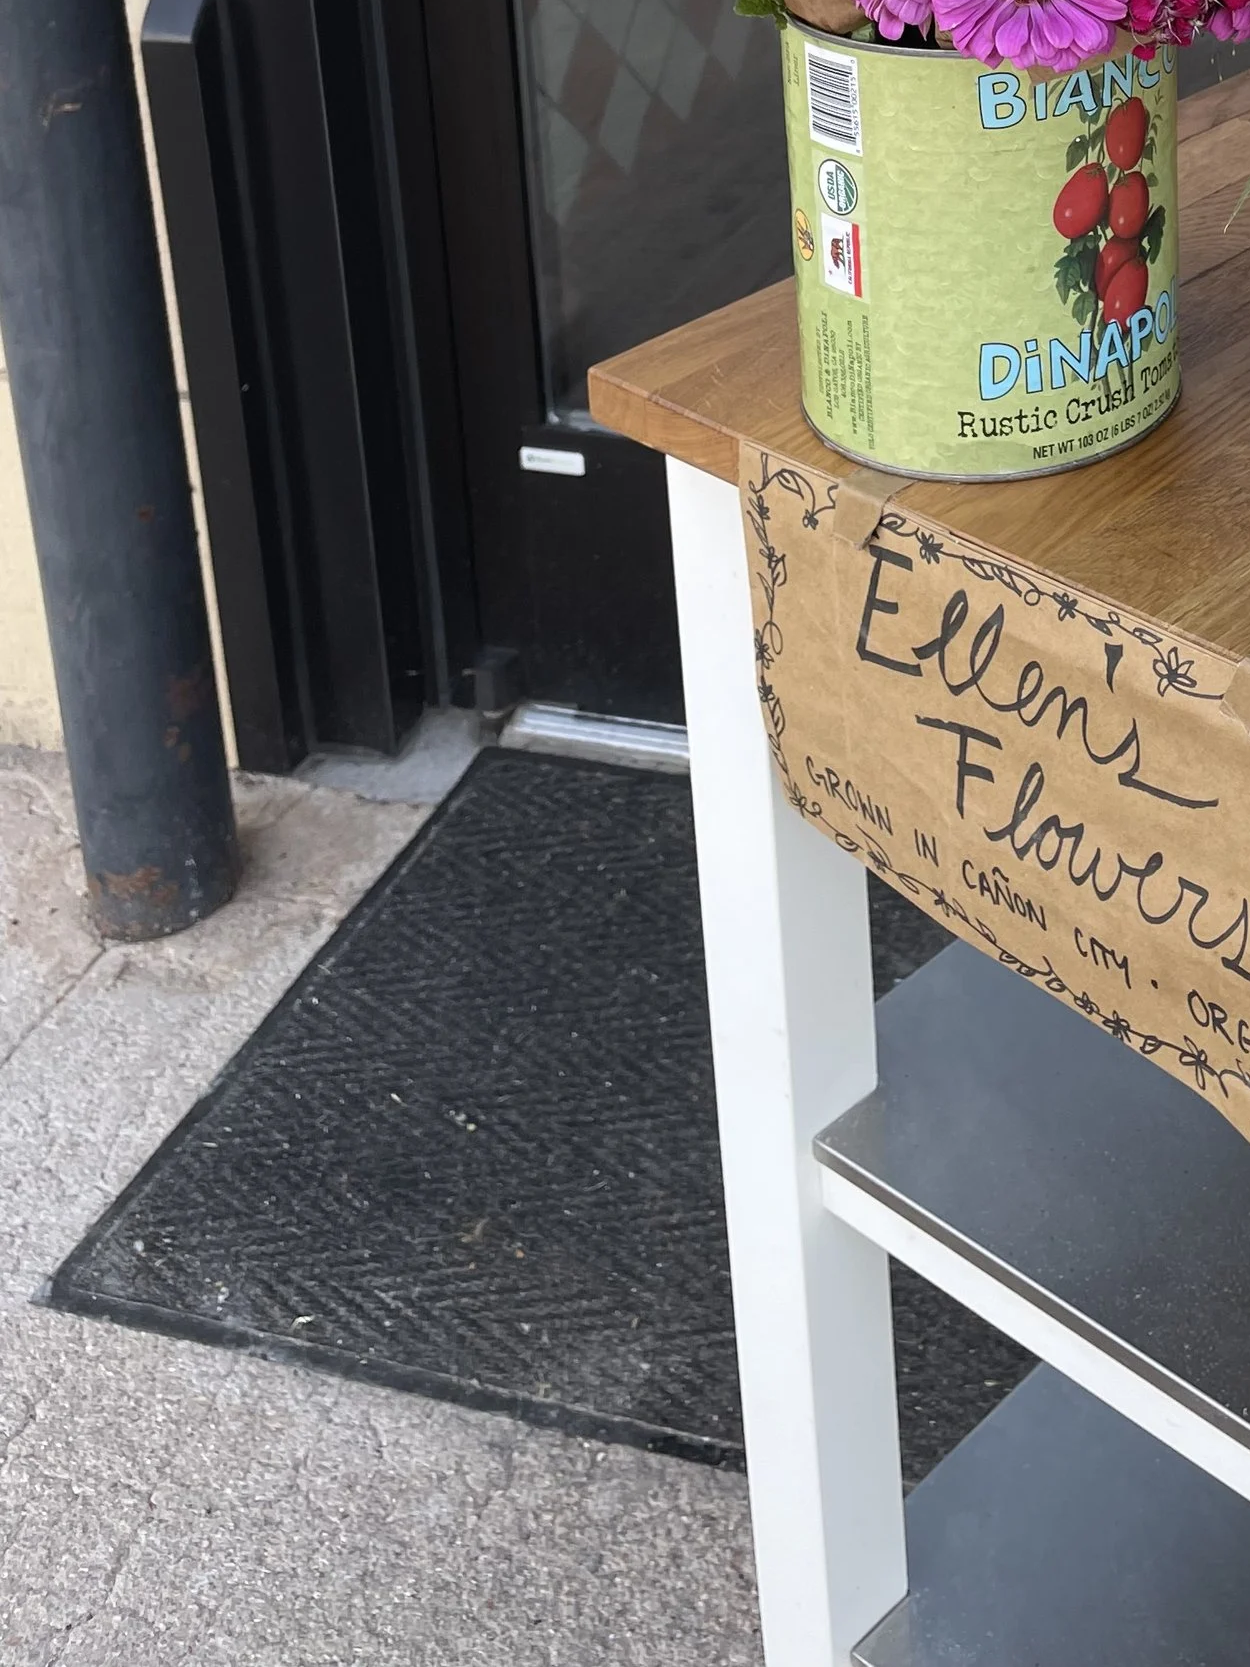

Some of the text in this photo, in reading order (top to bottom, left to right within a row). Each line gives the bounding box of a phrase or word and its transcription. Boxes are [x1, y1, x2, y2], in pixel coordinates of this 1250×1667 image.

[826, 172, 835, 200] USDA
[837, 170, 846, 208] ORGANIC
[958, 406, 1058, 439] Rustic
[1066, 380, 1135, 425] Crush
[1033, 444, 1053, 460] NET
[1058, 439, 1075, 454] WT
[1078, 434, 1093, 448] 103
[1096, 428, 1109, 441] OZ
[1120, 414, 1135, 434] LBS
[855, 545, 1220, 809] Ellen's
[805, 754, 893, 839] GROWN
[913, 826, 940, 868] IN
[962, 860, 1048, 931] CAÑON
[1073, 926, 1130, 991] CITY
